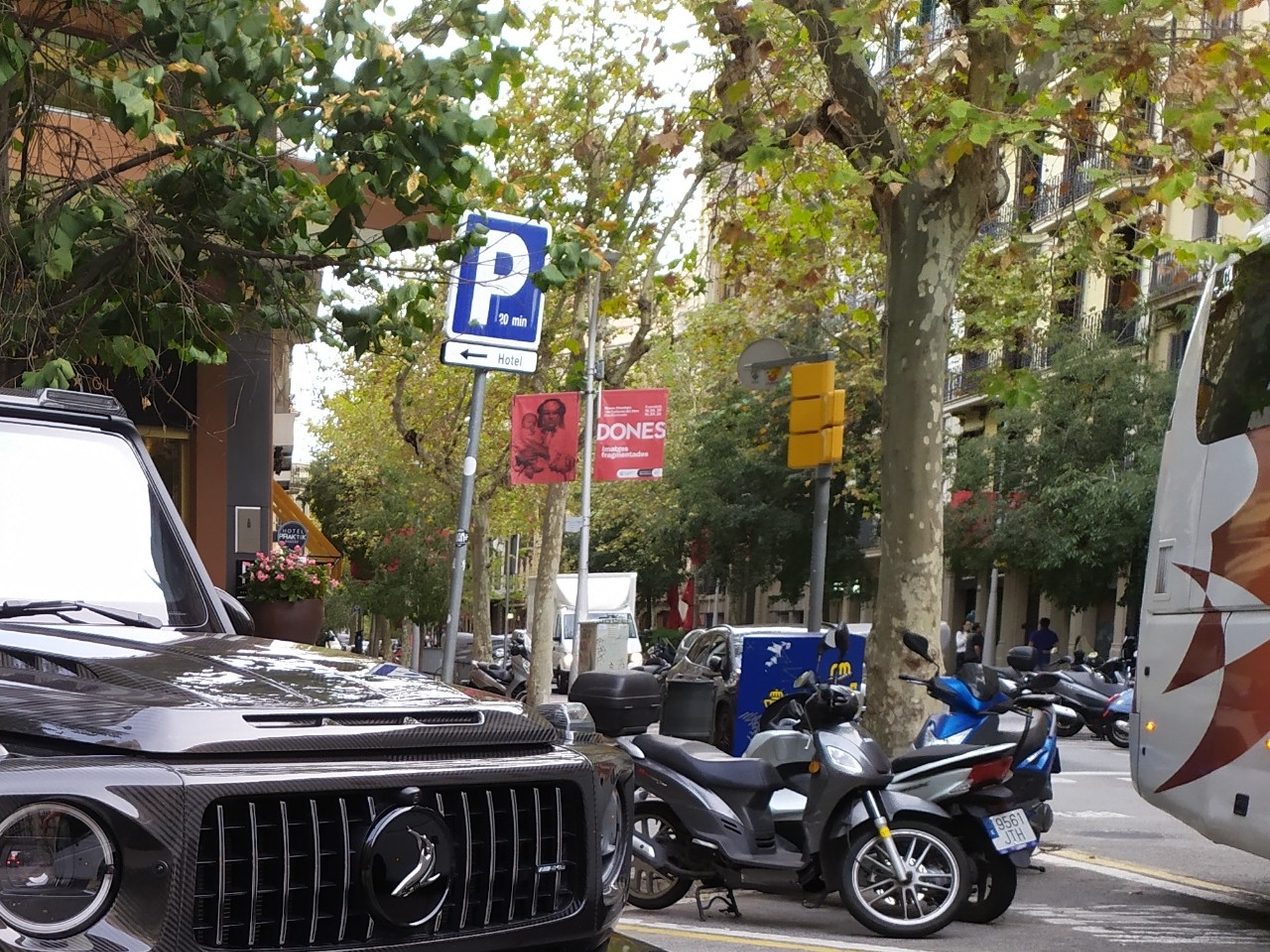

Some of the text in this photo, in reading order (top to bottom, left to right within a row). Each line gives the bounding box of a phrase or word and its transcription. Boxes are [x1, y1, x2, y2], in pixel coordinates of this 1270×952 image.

[469, 229, 530, 326] P
[511, 314, 528, 328] min
[498, 353, 523, 367] Hotel
[596, 421, 666, 441] DONES
[995, 812, 1025, 831] 9561
[1004, 827, 1027, 845] JTH
